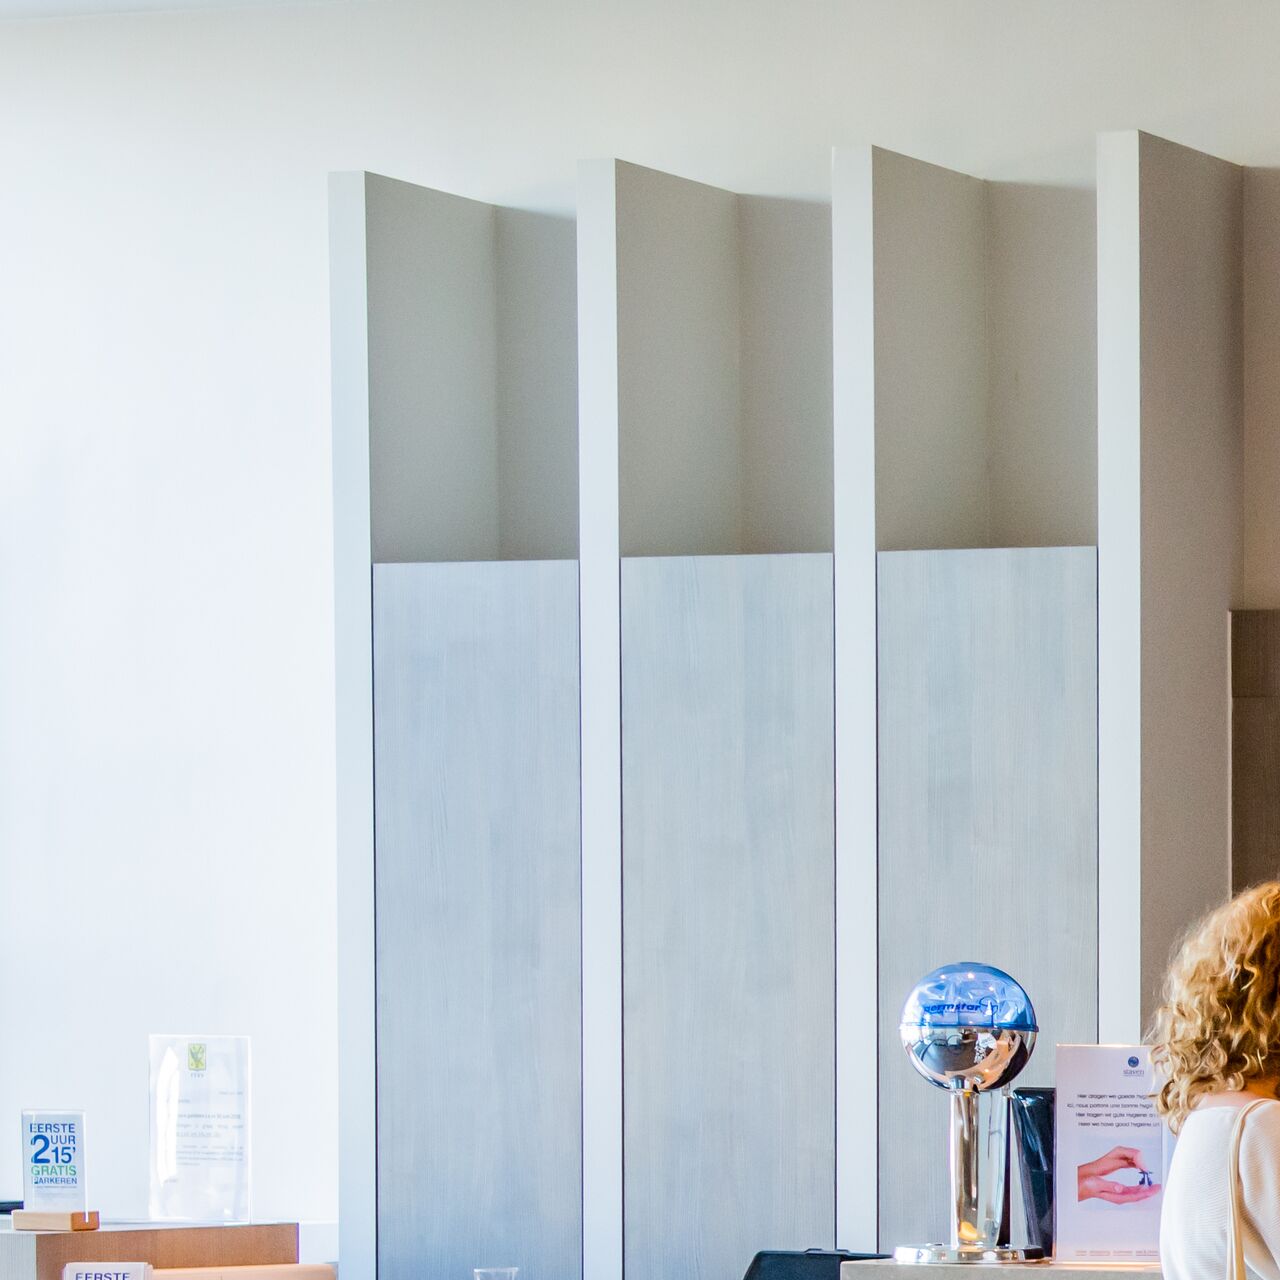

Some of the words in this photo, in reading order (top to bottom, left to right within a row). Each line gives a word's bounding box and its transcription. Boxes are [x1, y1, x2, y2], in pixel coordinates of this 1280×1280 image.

[29, 1123, 76, 1133] EERSTE
[31, 1134, 50, 1164] 2
[51, 1135, 76, 1145] UUR
[31, 1165, 77, 1176] GRATIS
